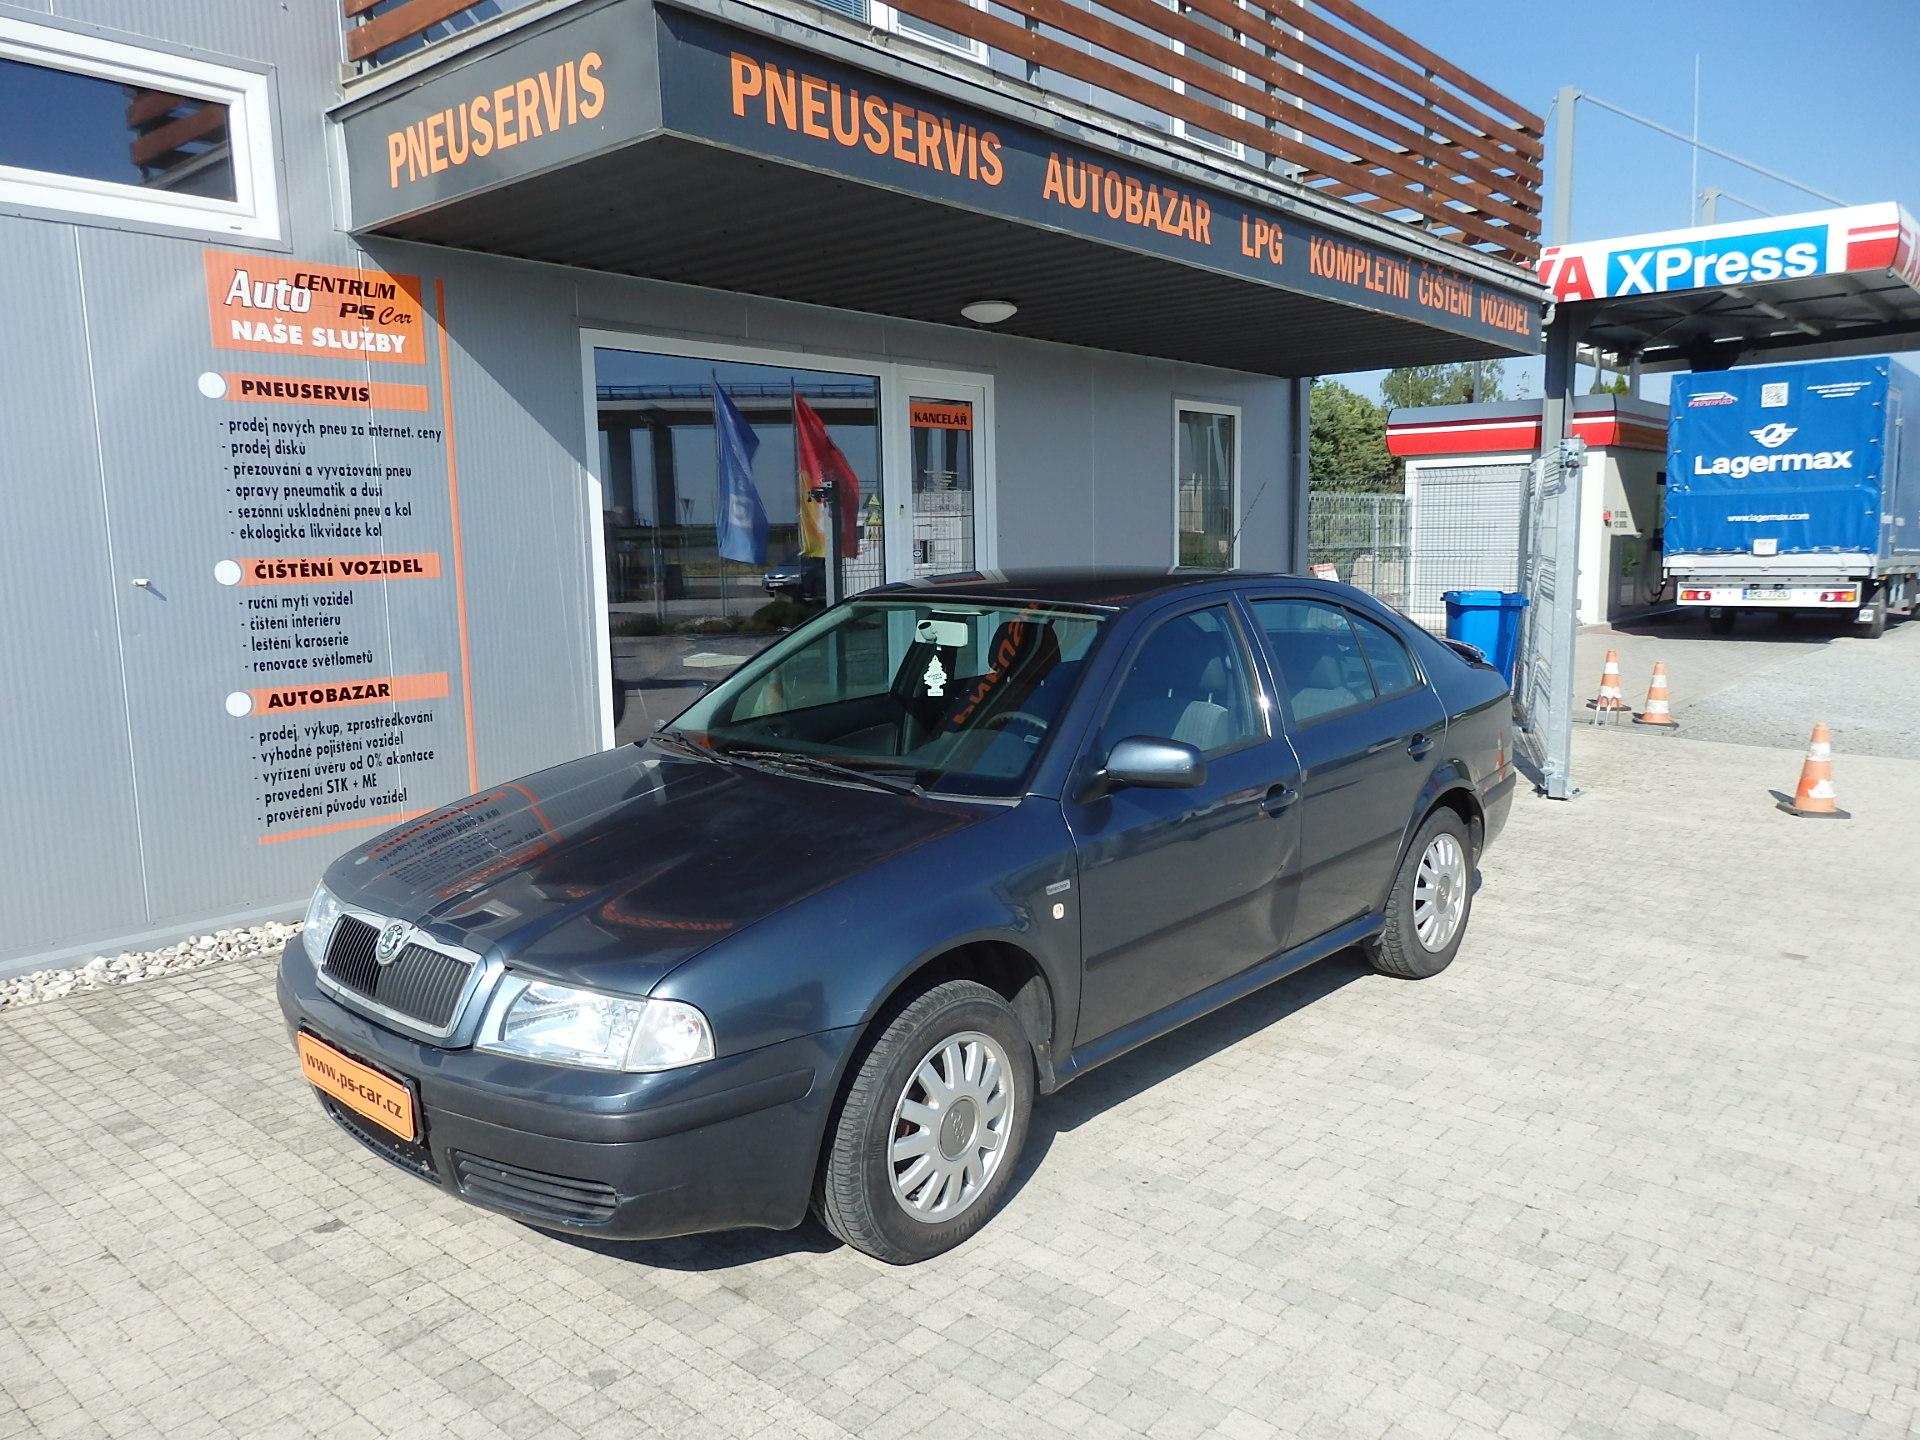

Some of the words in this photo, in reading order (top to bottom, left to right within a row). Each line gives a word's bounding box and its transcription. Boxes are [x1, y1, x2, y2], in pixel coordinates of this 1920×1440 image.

[387, 51, 606, 189] PNEUSERVIS
[729, 50, 1003, 186] PNEUSERVIS
[1042, 151, 1213, 246] AUTOBAZAR
[1241, 213, 1284, 265] LPG
[1308, 234, 1412, 301] KOMPLETNÍ
[1418, 259, 1473, 319] ČIŠTĚNÍ
[1479, 291, 1531, 337] VOZIDEL
[1616, 241, 1819, 297] XPress
[224, 268, 312, 314] Auto
[294, 272, 396, 301] CENTRUM
[339, 302, 375, 321] PS
[378, 306, 413, 326] Car
[231, 317, 304, 346] NAŠE
[311, 326, 407, 354] SLUŽBY
[241, 379, 370, 402] PNEUSERVIS
[229, 417, 269, 436] prodej
[273, 419, 315, 437] nových
[319, 424, 347, 438] pneu
[351, 425, 365, 436] za
[368, 422, 414, 438] internet.
[417, 429, 442, 443] ceny
[914, 411, 967, 426] KANCELÁŘ
[231, 438, 271, 458] prodej
[233, 462, 301, 479] přezouvání
[305, 466, 313, 476] a
[317, 464, 382, 480] vyvažování
[386, 467, 412, 480] pneu
[1694, 450, 1854, 479] Lagermax
[235, 486, 279, 501] opravy
[283, 482, 346, 501] pneumatik
[350, 487, 357, 497] a
[238, 503, 283, 518] sezónní
[287, 502, 350, 518] uskladnění
[354, 507, 381, 520] pneu
[384, 506, 391, 517] a
[394, 502, 412, 517] kol
[240, 523, 305, 543] ekologická
[310, 523, 362, 538] likvidace
[365, 522, 382, 537] kol
[254, 557, 333, 579] ČIŠTĚNÍ
[340, 559, 423, 576] VOZIDEL
[248, 595, 278, 610] ruční
[282, 593, 309, 611] mytí
[313, 590, 354, 607] vozidel
[250, 614, 288, 631] čištění
[292, 612, 341, 628] interiéru
[251, 635, 292, 652] leštění
[295, 631, 349, 648] karoserie
[253, 657, 308, 673] renovace
[312, 650, 373, 668] světlometů
[268, 683, 390, 709] AUTOBAZAR
[259, 723, 300, 747] prodej,
[304, 720, 343, 740] výkup,
[347, 710, 433, 735] zprostředkování
[261, 743, 312, 766] výhodné
[316, 738, 362, 760] pojištění
[365, 731, 404, 749] vozidel
[263, 763, 311, 786] vyřízení
[314, 761, 346, 776] úvěru
[350, 755, 363, 771] od
[366, 752, 383, 768] 0%
[386, 750, 435, 766] akontace
[265, 783, 323, 808] provedení
[326, 777, 349, 794] STK
[362, 773, 377, 789] ME
[266, 802, 323, 828] prověření
[327, 795, 366, 817] původu
[370, 787, 408, 807] vozidel
[305, 1052, 404, 1119] www.ps-car.cz
